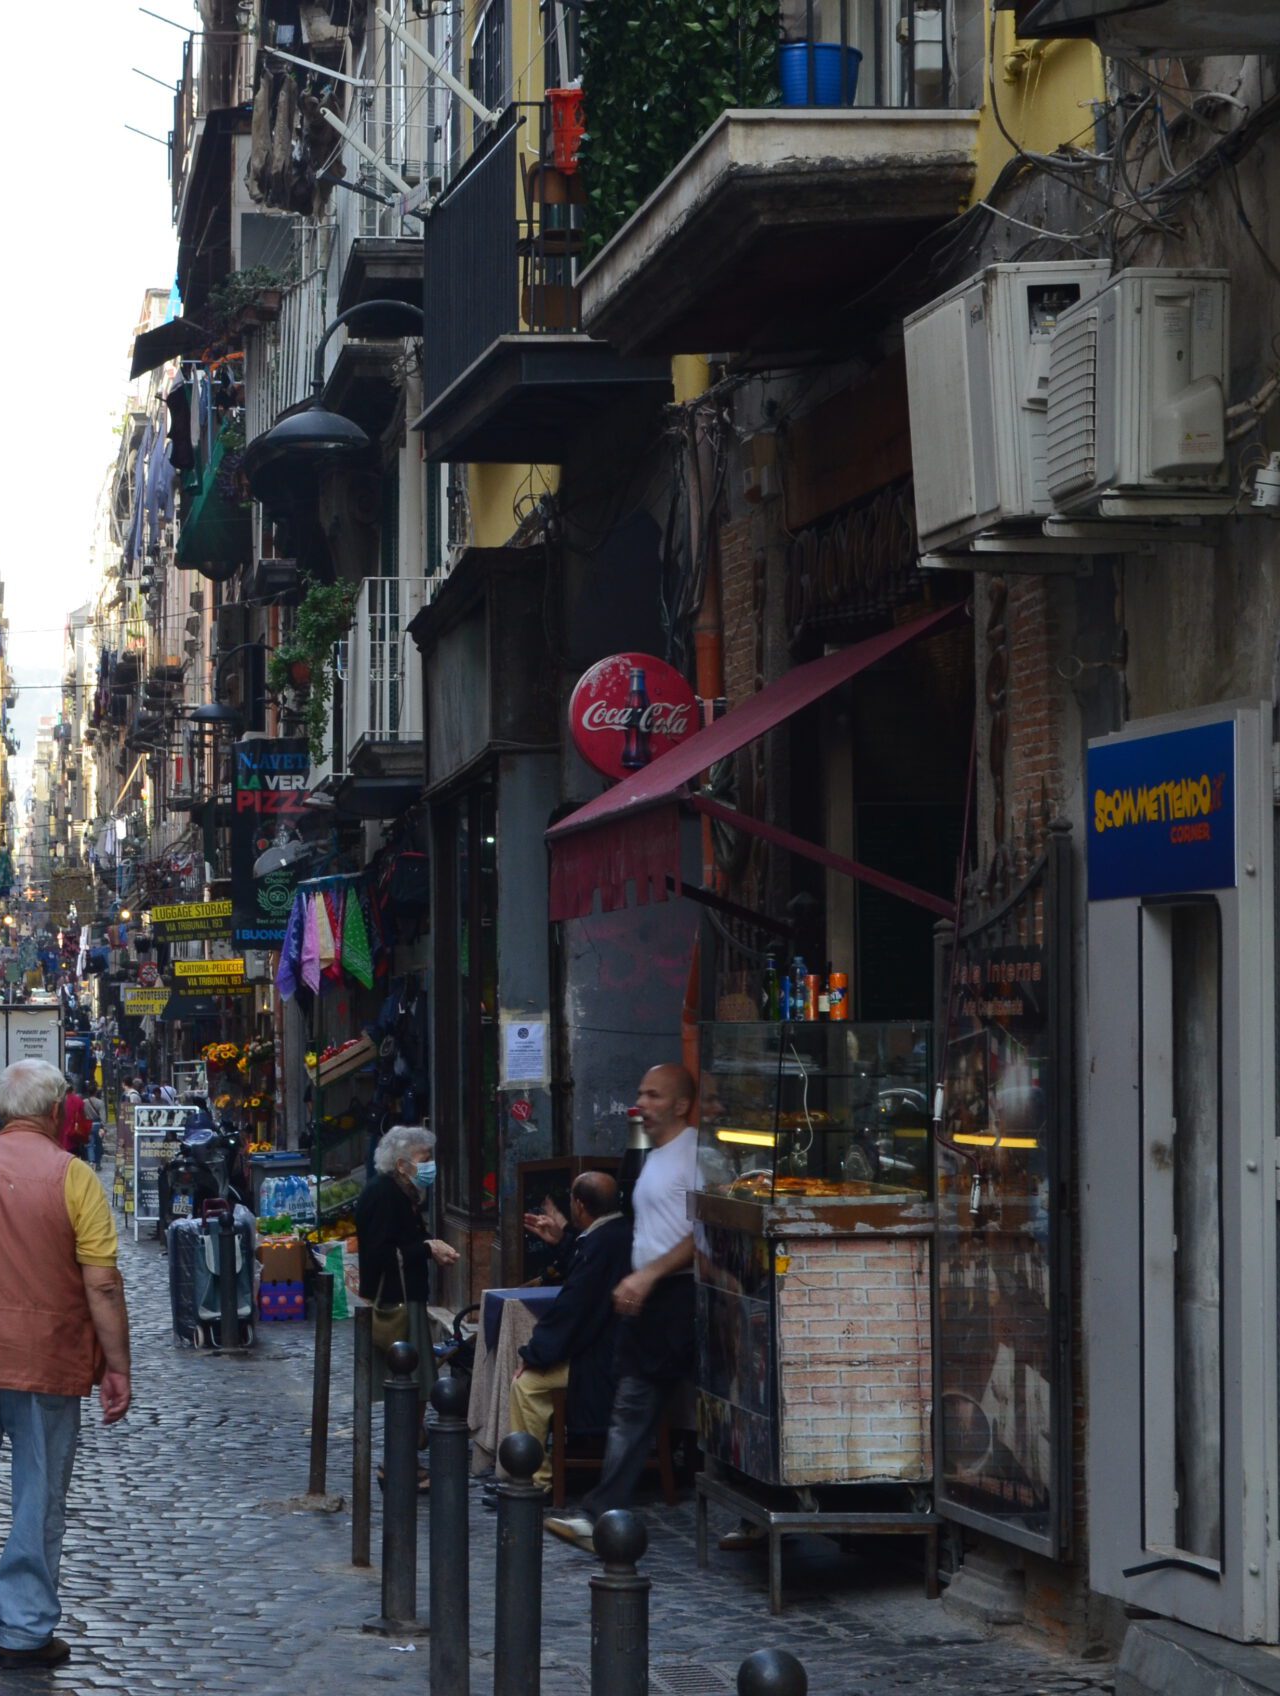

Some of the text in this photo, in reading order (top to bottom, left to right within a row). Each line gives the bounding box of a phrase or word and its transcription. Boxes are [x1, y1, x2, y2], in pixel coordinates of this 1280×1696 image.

[582, 700, 692, 738] Coca-Cola
[237, 775, 261, 790] LA
[1170, 822, 1211, 843] CORNER
[155, 902, 233, 920] LUGGAGE STORAGE
[166, 922, 176, 931] VIA
[212, 919, 223, 928] 193
[987, 960, 1041, 983] Interna
[187, 978, 198, 986] VIA
[232, 976, 241, 985] 193
